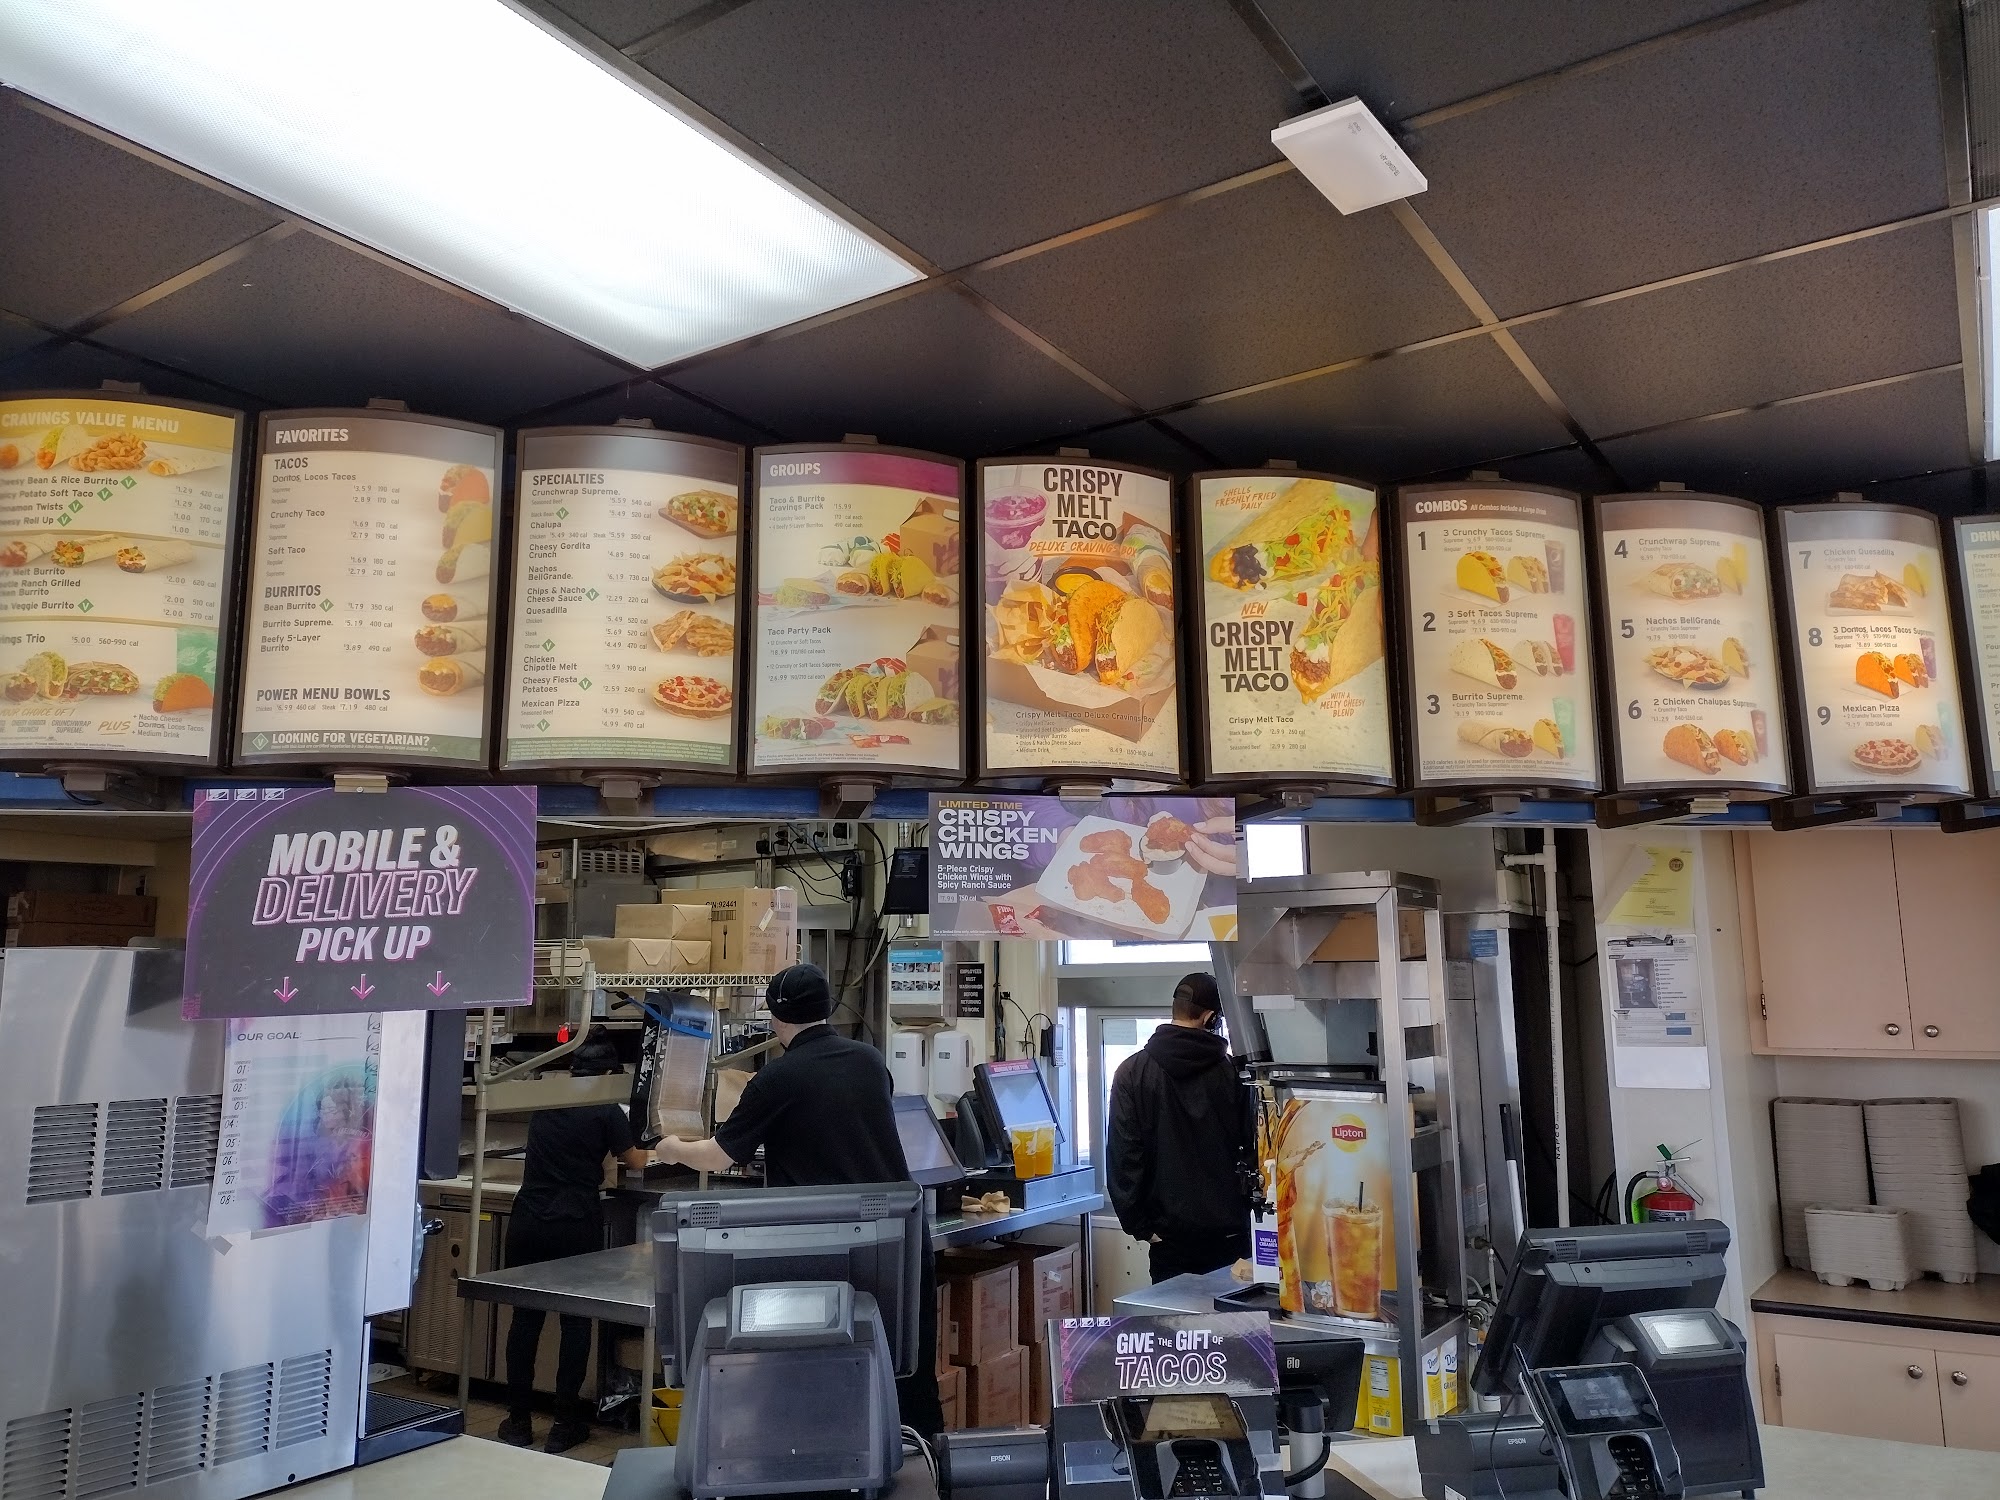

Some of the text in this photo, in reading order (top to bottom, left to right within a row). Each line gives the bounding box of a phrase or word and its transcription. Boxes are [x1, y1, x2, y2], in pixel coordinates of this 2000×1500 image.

[1, 412, 179, 433] CRAVINGS VALUE MENU
[275, 428, 349, 444] FAVORITES
[275, 457, 308, 469] TACOS
[770, 463, 821, 476] GROUPS
[28, 476, 48, 484] Bean
[51, 476, 57, 484] &
[61, 476, 80, 484] Rice
[83, 476, 119, 485] Burrito
[272, 474, 300, 482] Doritos
[304, 473, 328, 481] Locos
[533, 474, 605, 485] SPECIALTIES
[1043, 468, 1123, 496] CRISPY
[532, 488, 579, 496] Crunchwrap
[1223, 486, 1251, 497] SHELLS
[769, 497, 787, 505] Taco
[797, 495, 825, 503] Burrito
[1215, 492, 1276, 507] FRESHLY FRIED
[769, 504, 802, 512] Cravings
[1057, 494, 1112, 520] MELT
[1416, 500, 1467, 513] COMBOS
[270, 509, 325, 519] Crunchy Taco
[530, 521, 562, 529] Chalupa
[1053, 520, 1117, 541] TACO
[1417, 531, 1426, 550] 1
[1452, 529, 1487, 537] Crunchy
[1515, 530, 1545, 540] Supreme
[287, 546, 306, 554] Taco
[529, 543, 558, 552] Cheesy
[1029, 541, 1065, 551] DELUXE
[1614, 540, 1628, 558] 4
[1690, 538, 1720, 546] Supreme
[1799, 551, 1812, 569] 7
[528, 565, 557, 573] Nachos
[21, 580, 48, 588] Ranch
[51, 579, 81, 587] Grilled
[265, 585, 321, 598] BURRITOS
[527, 587, 549, 595] Chips
[526, 595, 554, 603] Cheese
[264, 602, 316, 611] Bean Burrito
[526, 606, 567, 615] Quesadilla
[1241, 601, 1268, 616] NEW
[263, 620, 291, 628] Burrito
[1423, 612, 1436, 632] 2
[1506, 610, 1538, 619] Supreme
[767, 626, 831, 636] Taco Party Pack
[1621, 619, 1635, 638] 5
[1680, 617, 1721, 625] BellGrande
[261, 634, 321, 644] Beefy 5-Layer
[1210, 620, 1294, 647] CRISPY
[1808, 627, 1823, 647] 8
[1894, 626, 1912, 634] Tacos
[26, 634, 46, 644] Trio
[98, 638, 127, 646] 560-990
[129, 638, 139, 647] cal
[260, 644, 289, 652] Burrito
[524, 656, 555, 664] Chicken
[1224, 647, 1282, 672] MELT
[523, 663, 577, 673] Chipotle Melt
[522, 676, 578, 685] Cheesy Fiesta
[1221, 673, 1289, 692] TACO
[257, 688, 391, 701] POWER MENU BOWLS
[522, 685, 558, 693] Potatoes
[521, 699, 580, 708] Mexican Pizza
[1320, 699, 1366, 710] MELTY CHEESY
[1426, 695, 1440, 714] 3
[1452, 693, 1484, 701] Burrito
[1628, 700, 1642, 719] 6
[1698, 698, 1731, 706] Chalupas
[1015, 711, 1041, 720] Crispy
[1111, 712, 1141, 722] Cravings
[1332, 709, 1354, 717] BLEND
[1817, 706, 1831, 725] 9
[1229, 716, 1254, 724] Crispy
[97, 721, 130, 731] PLUS
[272, 733, 430, 746] LOOKING FOR VEGETARIAN?
[939, 800, 1023, 810] LIMITED TIME
[938, 809, 1035, 827] CRISPY
[938, 826, 1057, 843] CHICKEN
[267, 824, 460, 876] MOBILE &
[938, 844, 1030, 860] WINGS
[937, 865, 994, 875] 5-Piece Crispy
[937, 872, 1012, 882] Chicken Wings with
[937, 881, 1012, 891] Spicy Ranch Sauce
[251, 867, 479, 926] DELIVERY
[296, 925, 431, 962] PICK UP
[237, 1032, 263, 1041] OUR
[1335, 1128, 1364, 1138] Lipton
[1116, 1329, 1224, 1355] GIVE THE GIFT OF
[1114, 1351, 1227, 1390] TACOS
